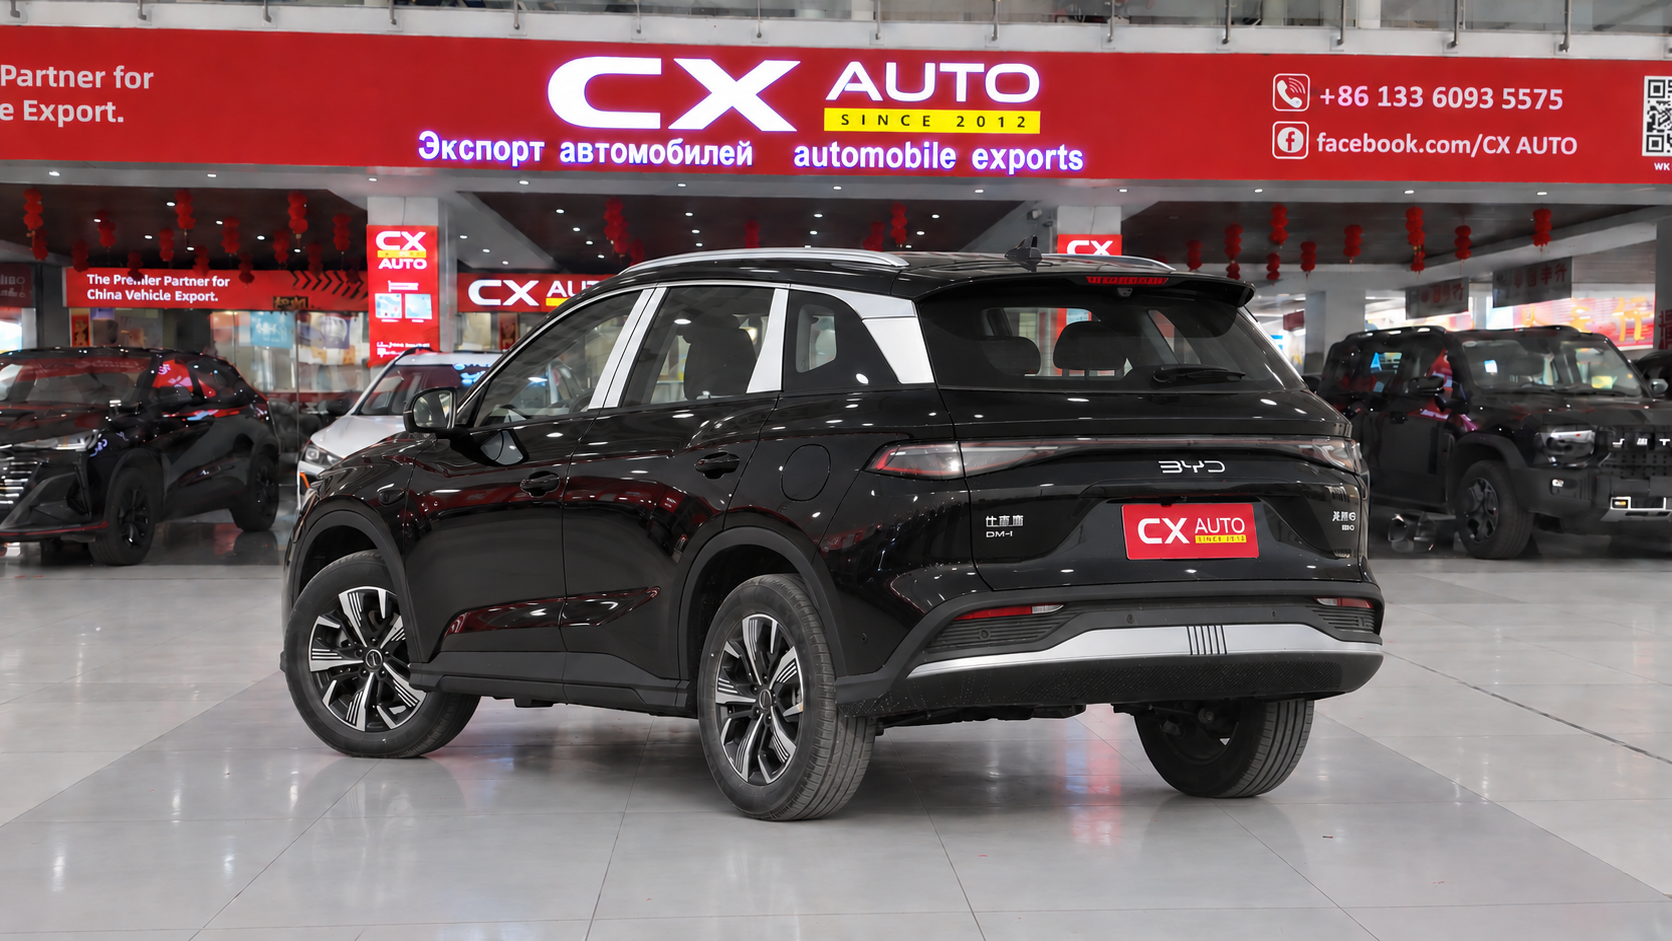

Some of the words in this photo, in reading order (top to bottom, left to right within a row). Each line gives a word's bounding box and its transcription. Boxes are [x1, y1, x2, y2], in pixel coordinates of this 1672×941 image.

[0, 64, 106, 88] Partner
[113, 65, 154, 89] for
[547, 56, 801, 132] CX
[825, 61, 1040, 103] AUTO
[1320, 85, 1369, 107] +86
[1377, 85, 1424, 107] 133
[1432, 86, 1494, 108] 6093
[1501, 88, 1564, 110] 5575
[23, 100, 124, 128] Export.
[841, 114, 931, 127] SINCE
[956, 115, 1026, 128] 2012
[418, 130, 545, 167] Экспорт
[559, 137, 753, 166] автомобилей
[1317, 132, 1511, 158] facebook.com/CX
[1515, 136, 1578, 155] AUTO
[794, 141, 957, 169] automobile
[972, 144, 1084, 175] exports
[375, 231, 427, 251] CX
[378, 258, 427, 270] AUTO
[86, 273, 110, 285] The
[113, 274, 162, 286] Preier
[164, 275, 210, 287] Partner
[212, 276, 231, 287] for
[87, 289, 122, 300] China
[125, 289, 171, 301] Vehicle
[175, 290, 219, 304] Export.
[467, 279, 540, 307] CX
[1158, 460, 1226, 474] BYD
[1137, 517, 1190, 544] CX
[1194, 517, 1246, 534] AUTO
